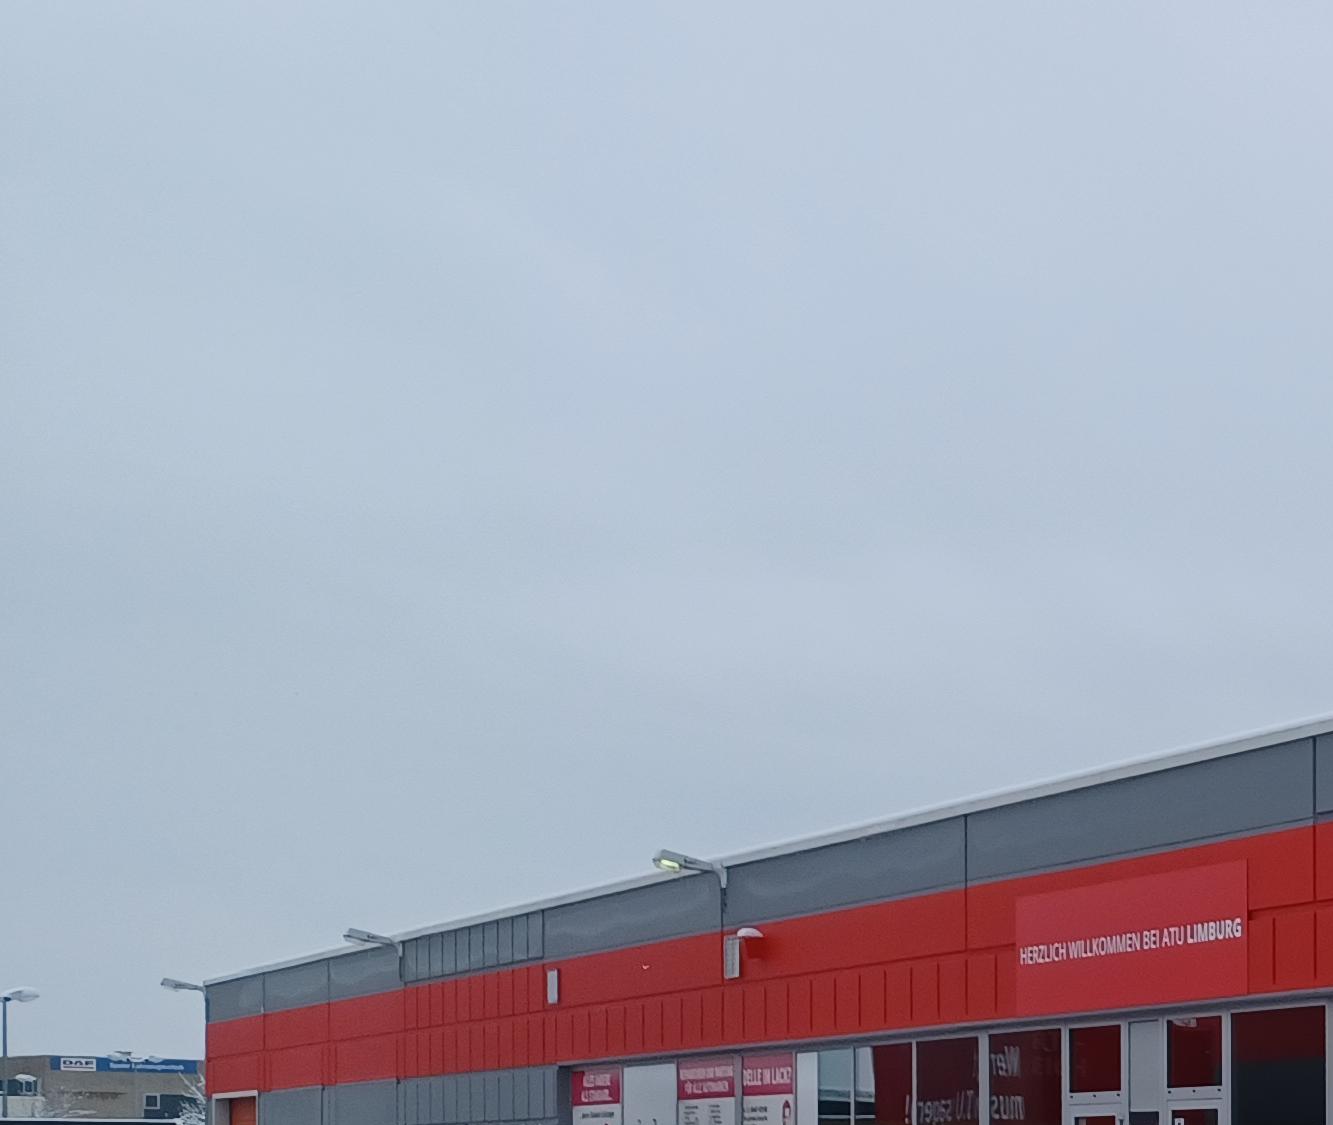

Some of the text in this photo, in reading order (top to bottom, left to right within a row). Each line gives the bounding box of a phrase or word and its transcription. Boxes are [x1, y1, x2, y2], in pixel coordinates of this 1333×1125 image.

[1020, 917, 1242, 966] HERZLICH WILLKOMMEN BEI ATU LIMBURG
